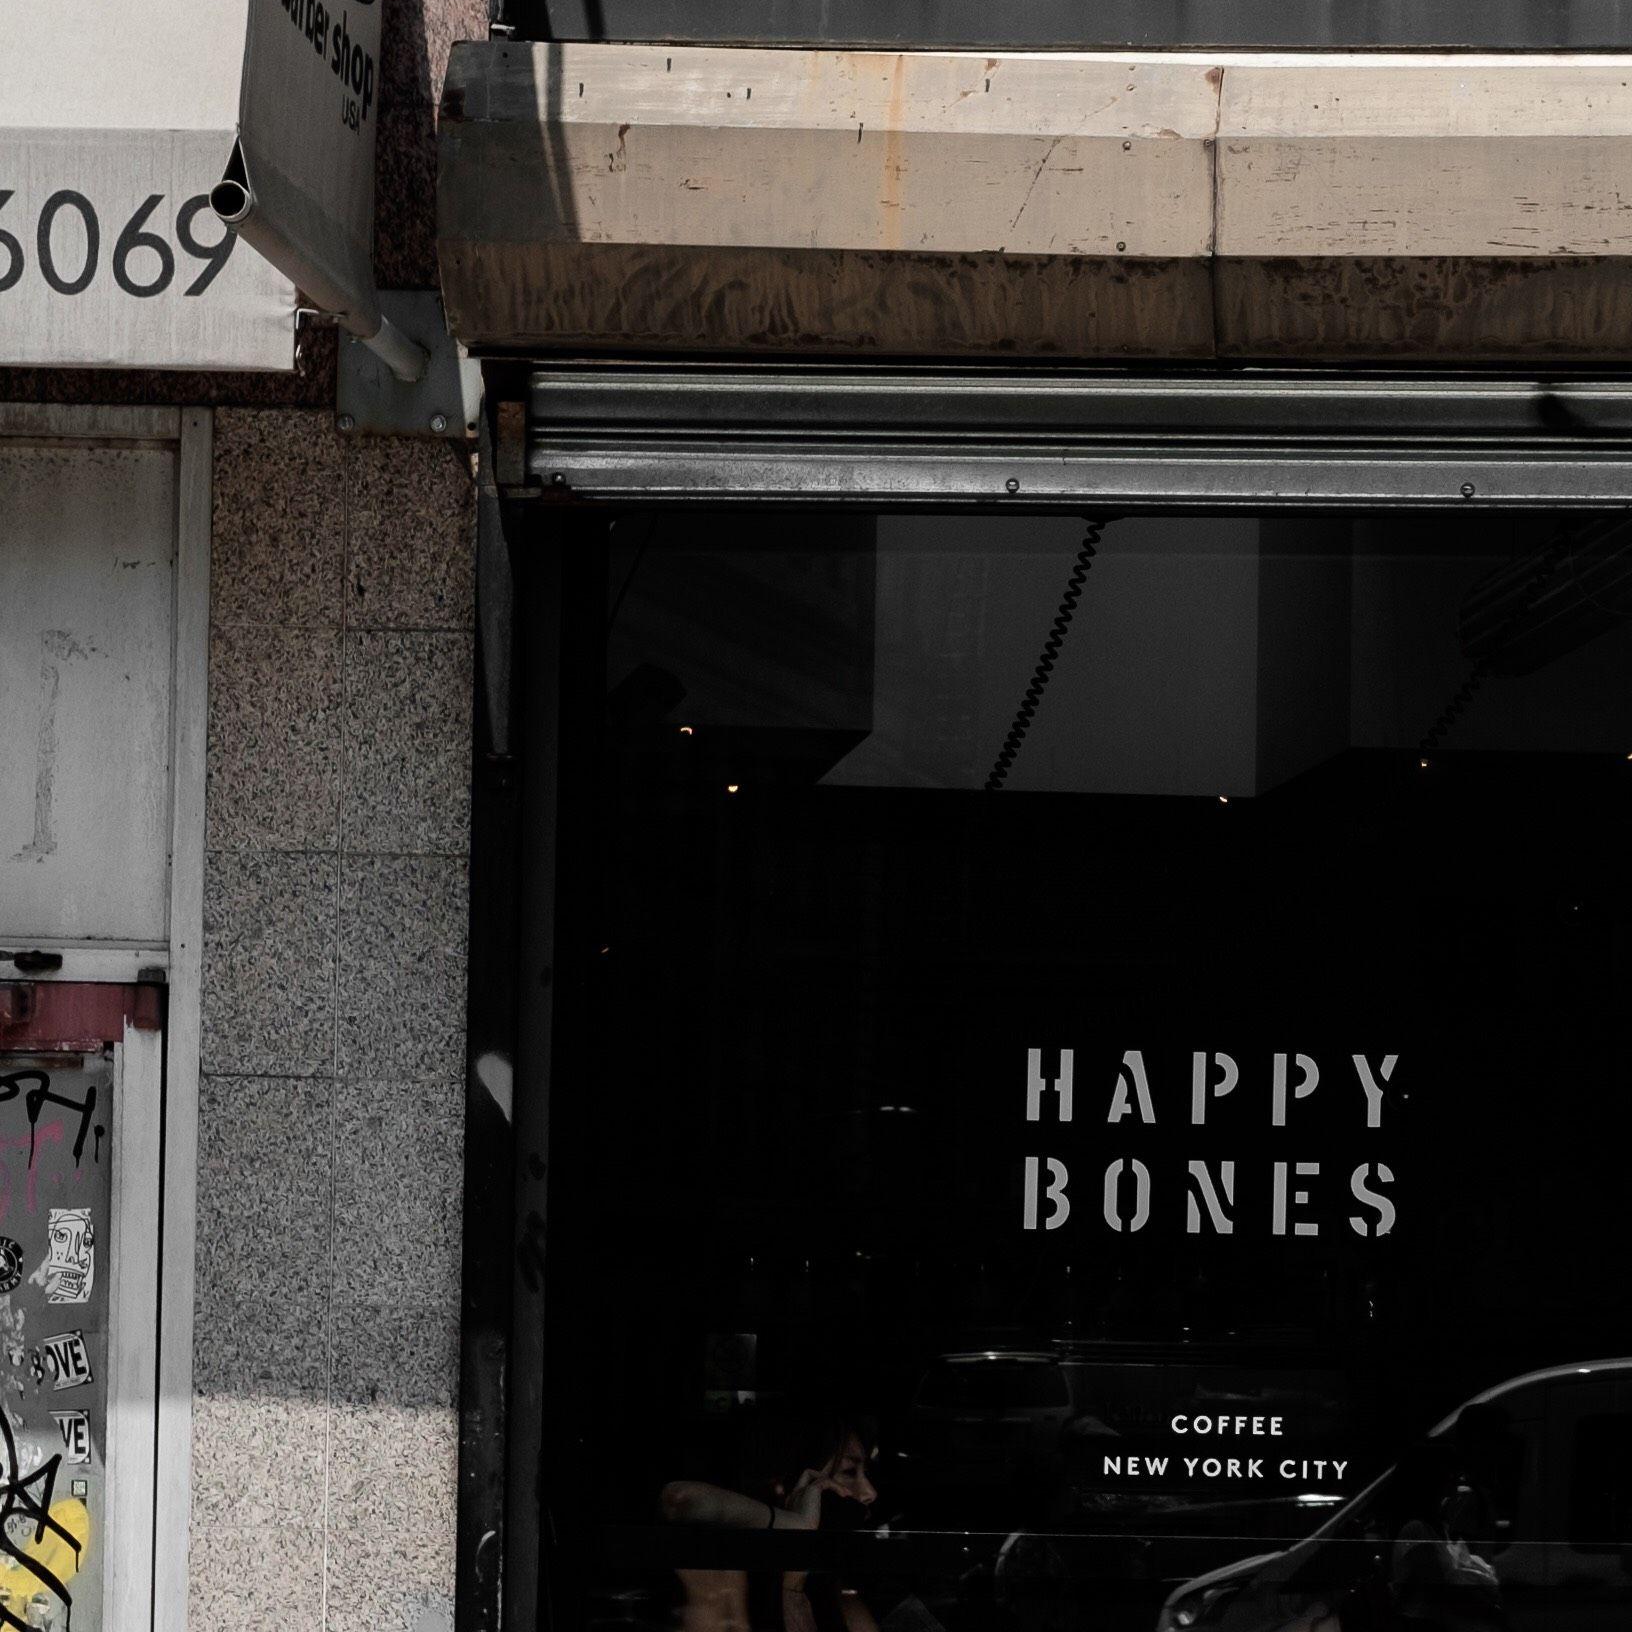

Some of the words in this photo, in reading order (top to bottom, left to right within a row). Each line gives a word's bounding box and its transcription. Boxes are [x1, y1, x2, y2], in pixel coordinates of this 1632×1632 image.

[331, 9, 374, 120] shop
[342, 94, 360, 135] USA
[1026, 1048, 1399, 1128] HAPPY
[1023, 1156, 1396, 1237] BONES
[1171, 1415, 1284, 1436] COFFEE
[1103, 1456, 1169, 1476] NEW
[1183, 1457, 1263, 1478] YORK
[1280, 1459, 1348, 1480] CITY
